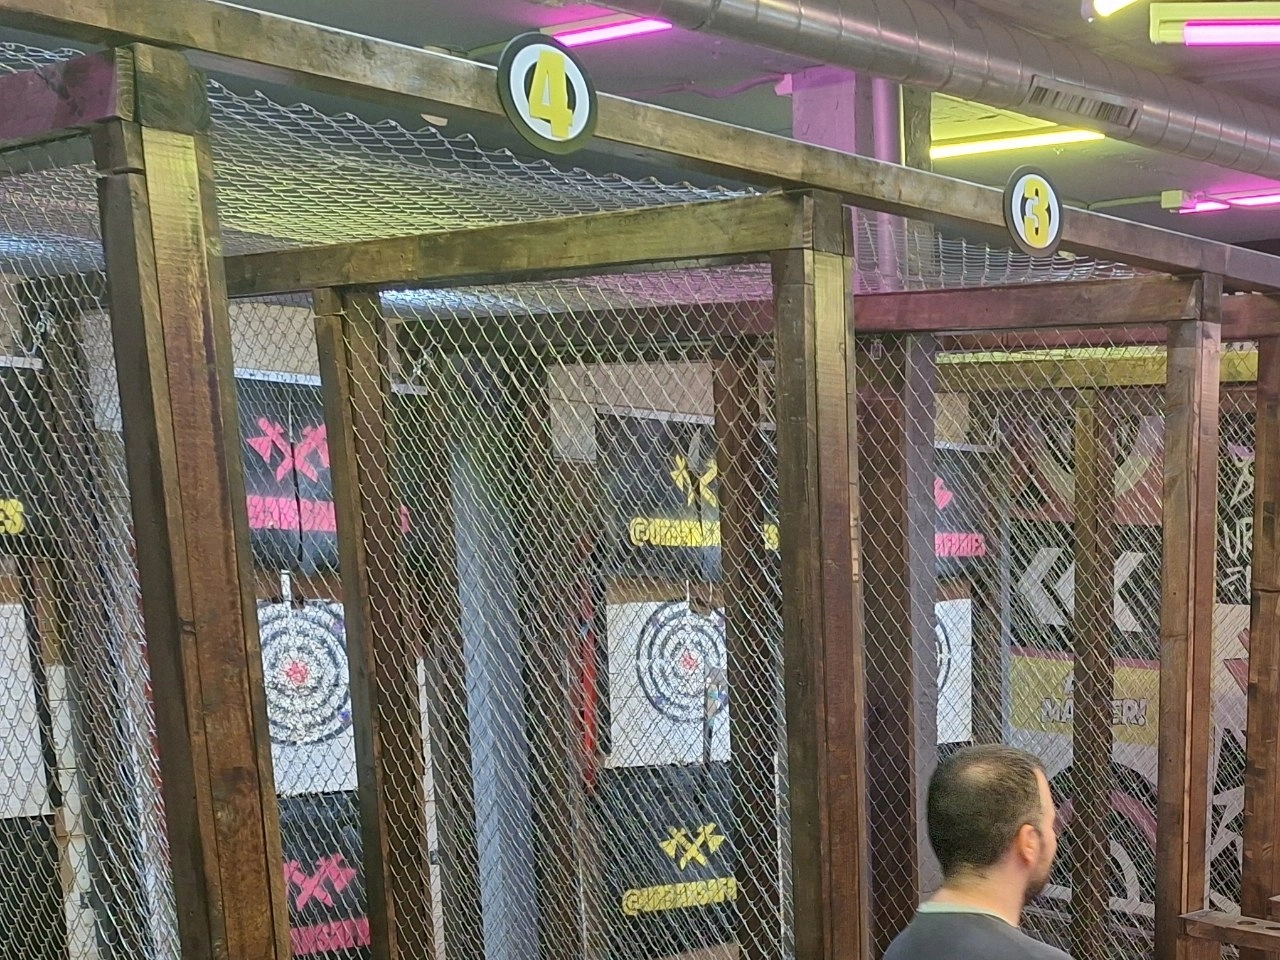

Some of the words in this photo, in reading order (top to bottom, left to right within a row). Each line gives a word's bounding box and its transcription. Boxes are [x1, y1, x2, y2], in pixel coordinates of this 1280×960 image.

[528, 49, 573, 139] 4
[1022, 179, 1050, 249] 3
[1041, 697, 1147, 726] MAER!
